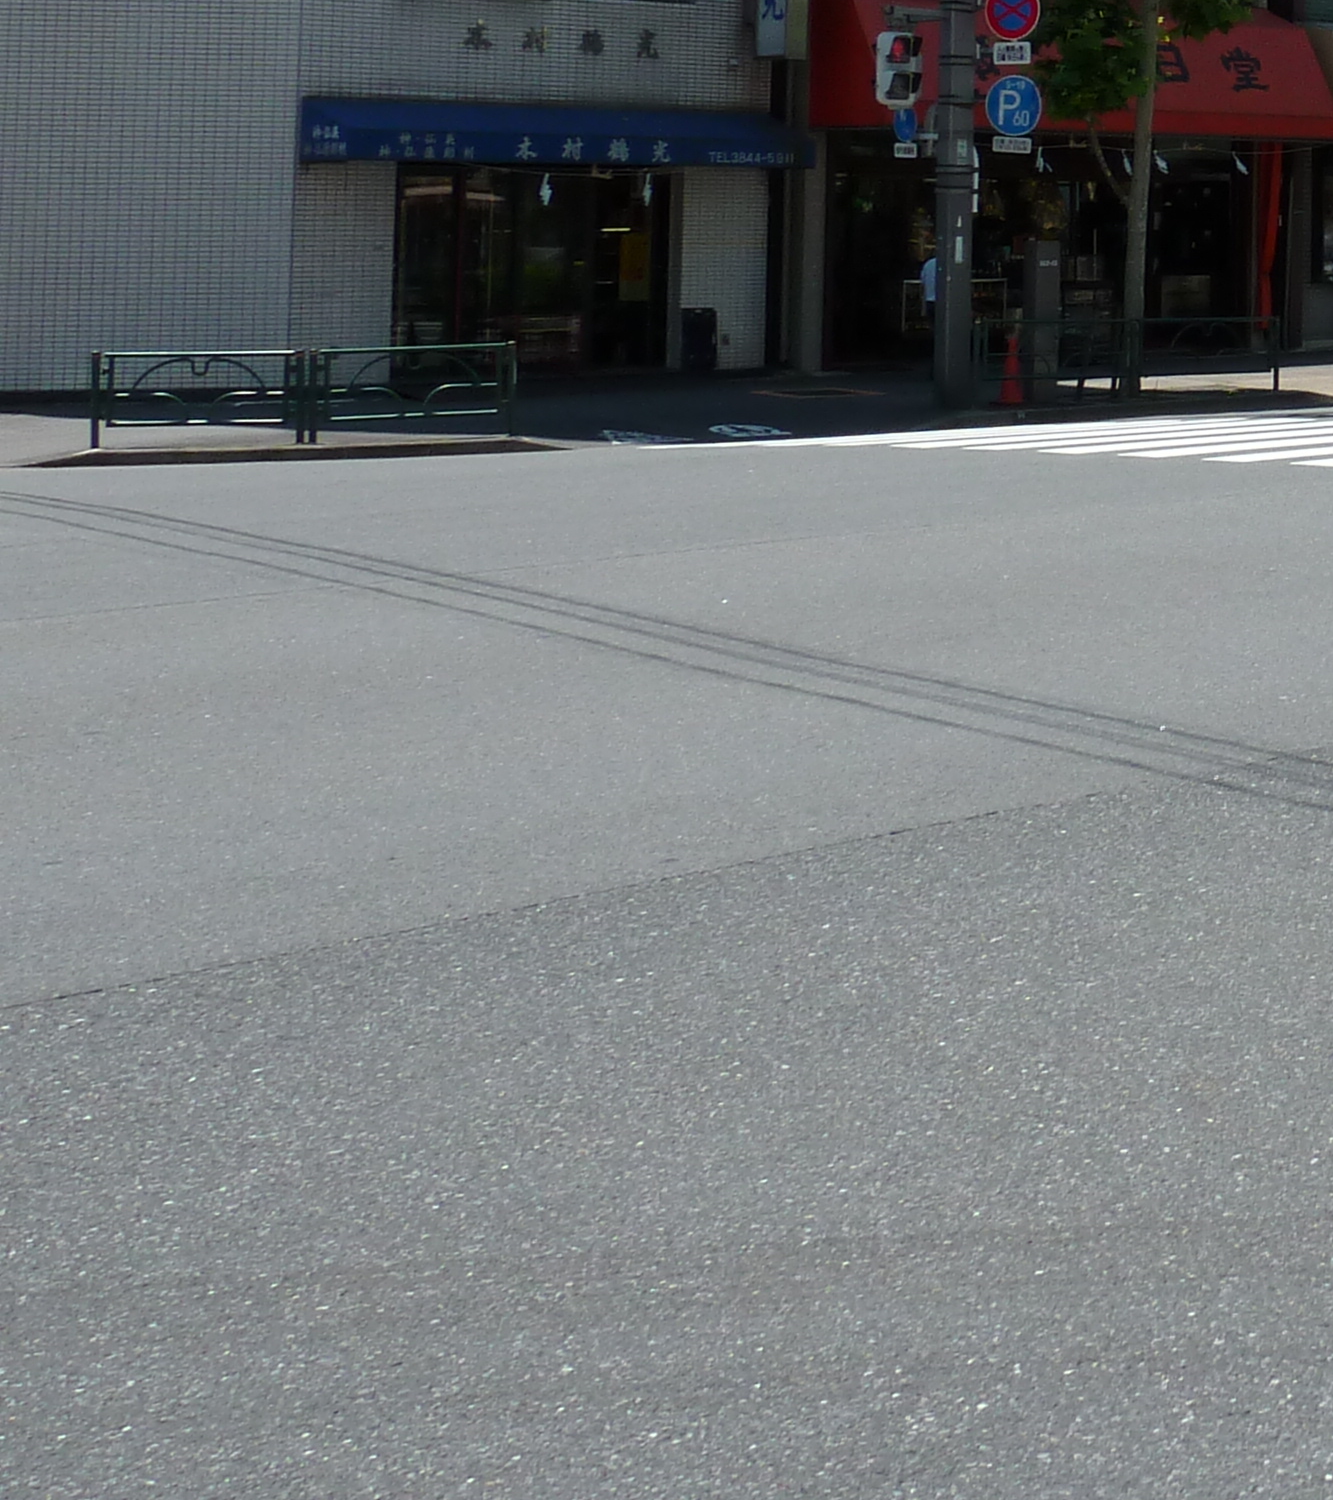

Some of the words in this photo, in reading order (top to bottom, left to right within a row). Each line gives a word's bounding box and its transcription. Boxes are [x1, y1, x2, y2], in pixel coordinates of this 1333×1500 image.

[997, 89, 1022, 126] P
[1012, 110, 1030, 127] 60
[515, 135, 672, 163] 木村鶴光
